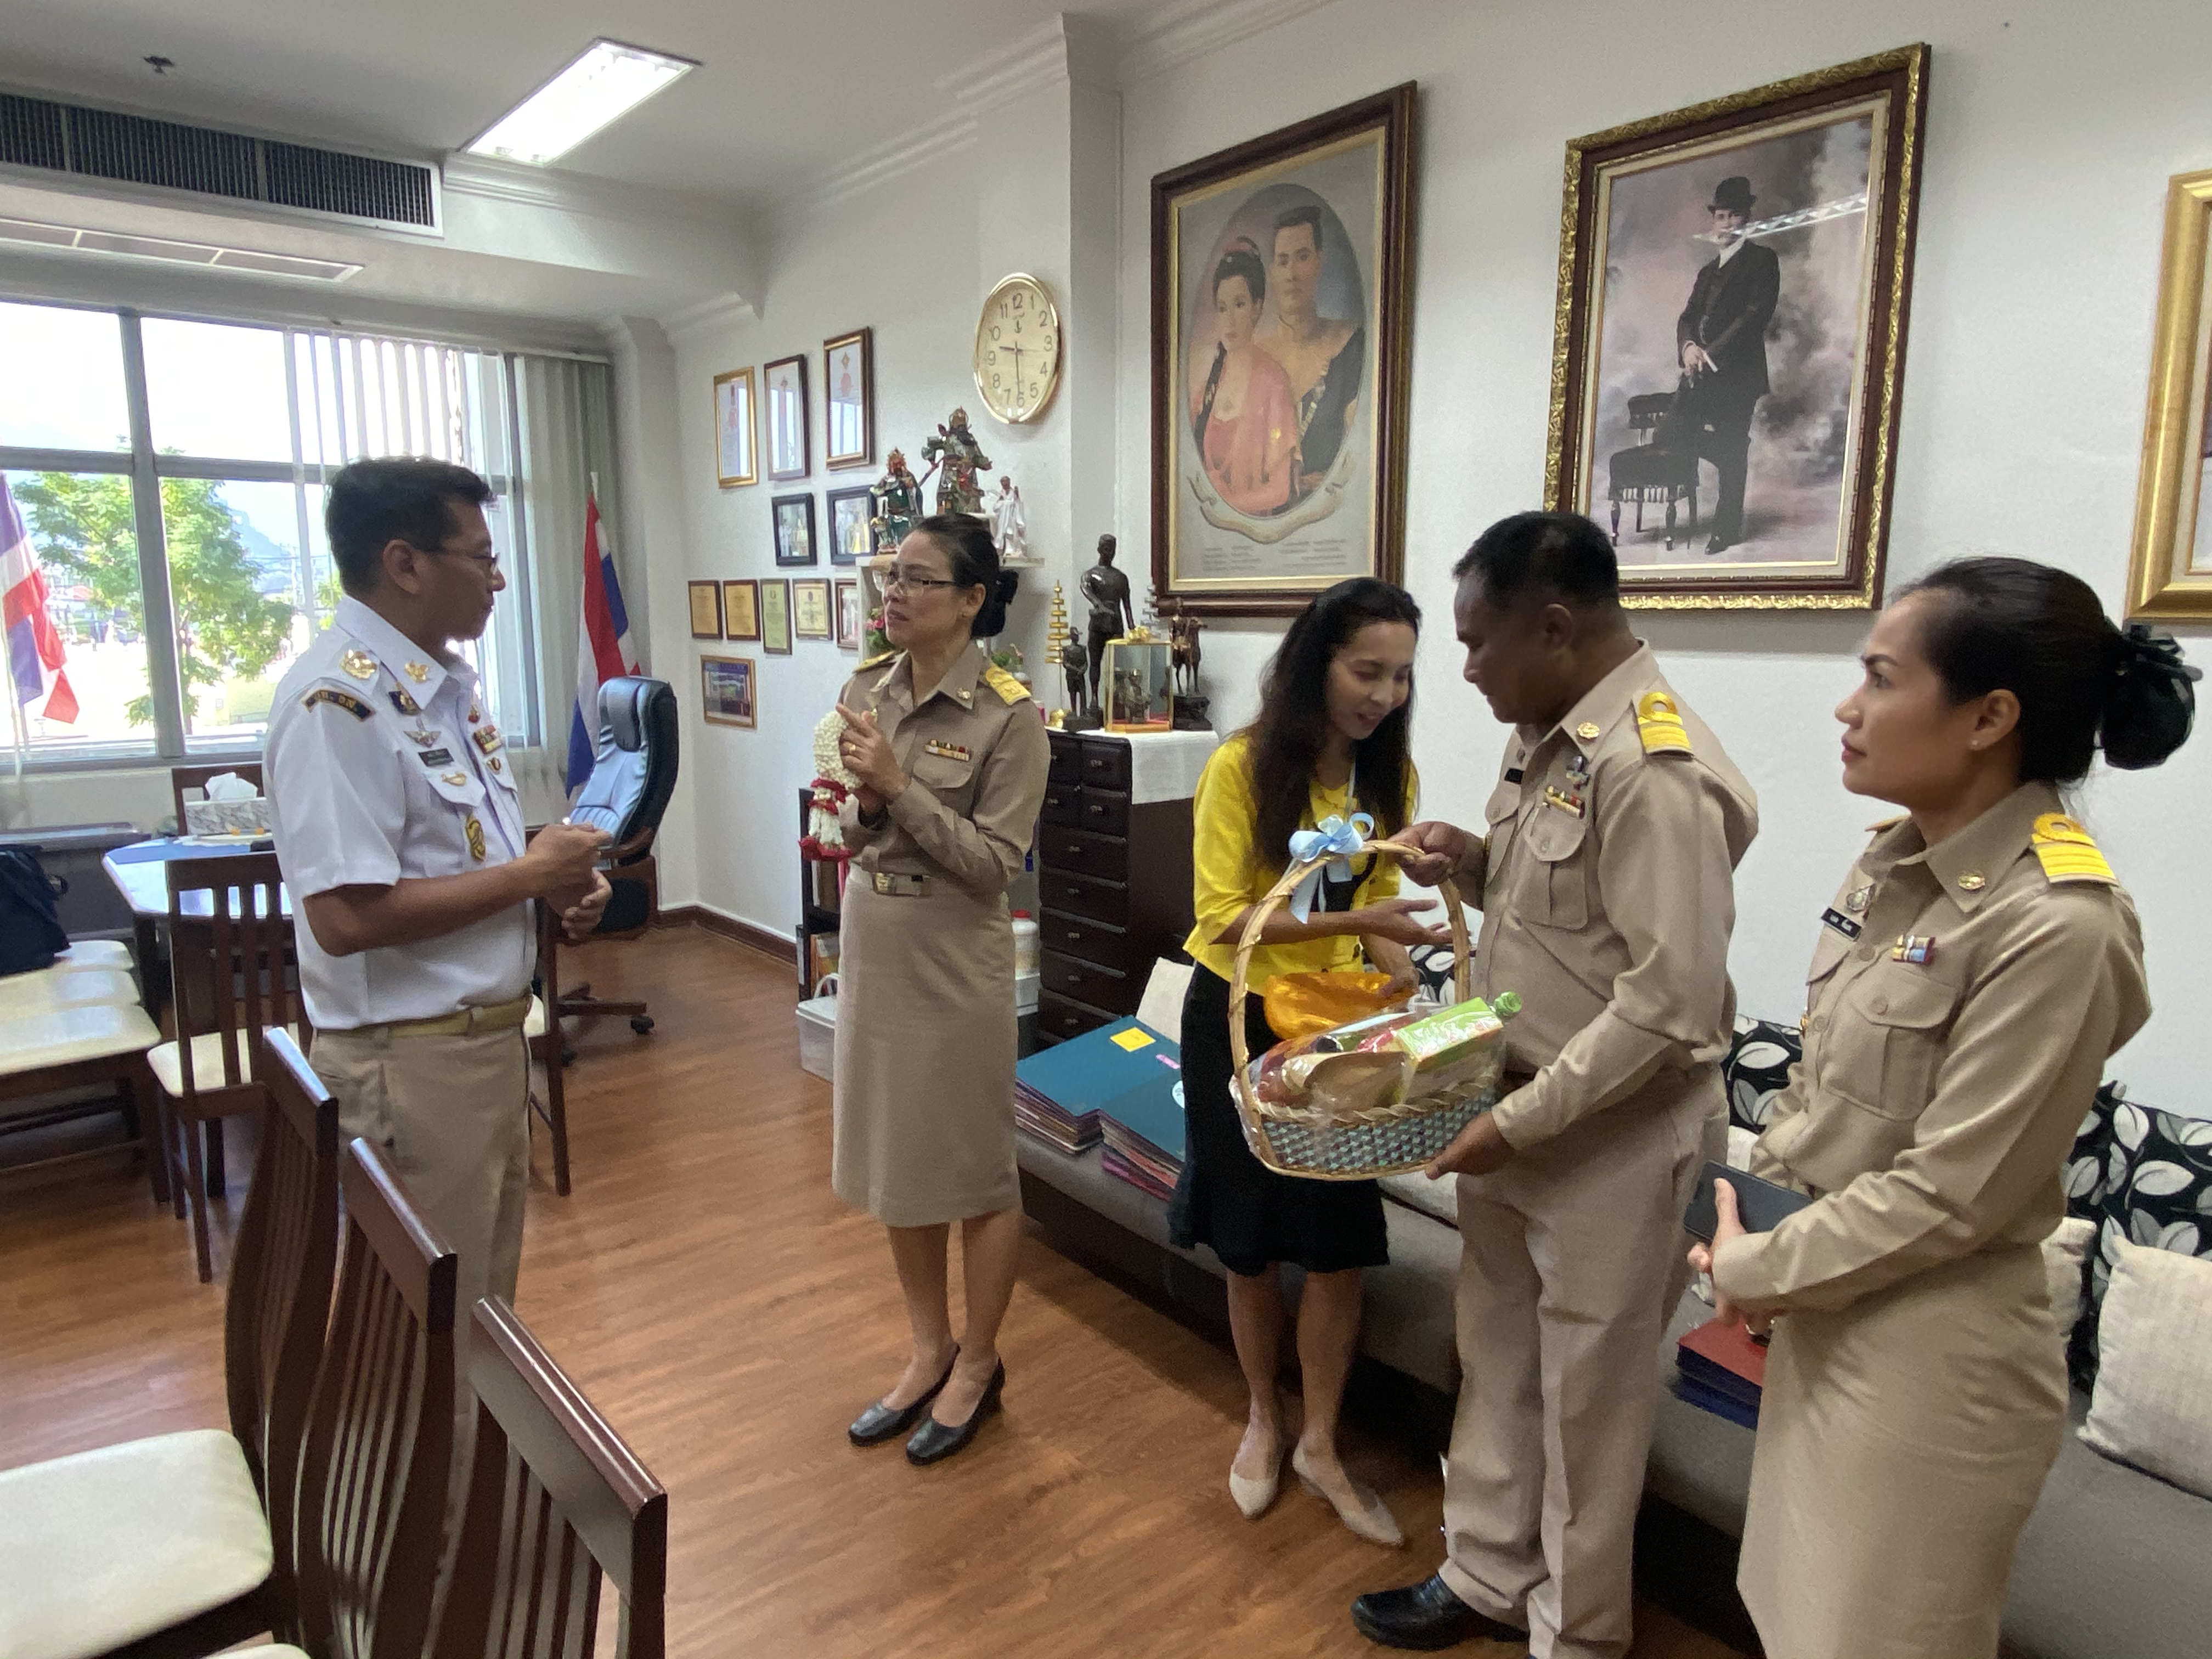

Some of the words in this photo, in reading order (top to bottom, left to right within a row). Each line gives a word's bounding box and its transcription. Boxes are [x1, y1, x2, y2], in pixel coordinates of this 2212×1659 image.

[1012, 292, 1023, 309] 12
[1030, 294, 1035, 309] 1
[1000, 302, 1008, 319] 11
[1039, 311, 1047, 327] 2
[1043, 335, 1052, 352] 3
[988, 351, 996, 366] 9
[1040, 362, 1048, 377] 4
[993, 373, 1001, 388] 8
[1003, 388, 1011, 405] 7
[1030, 382, 1039, 398] 5
[1016, 392, 1025, 408] 6
